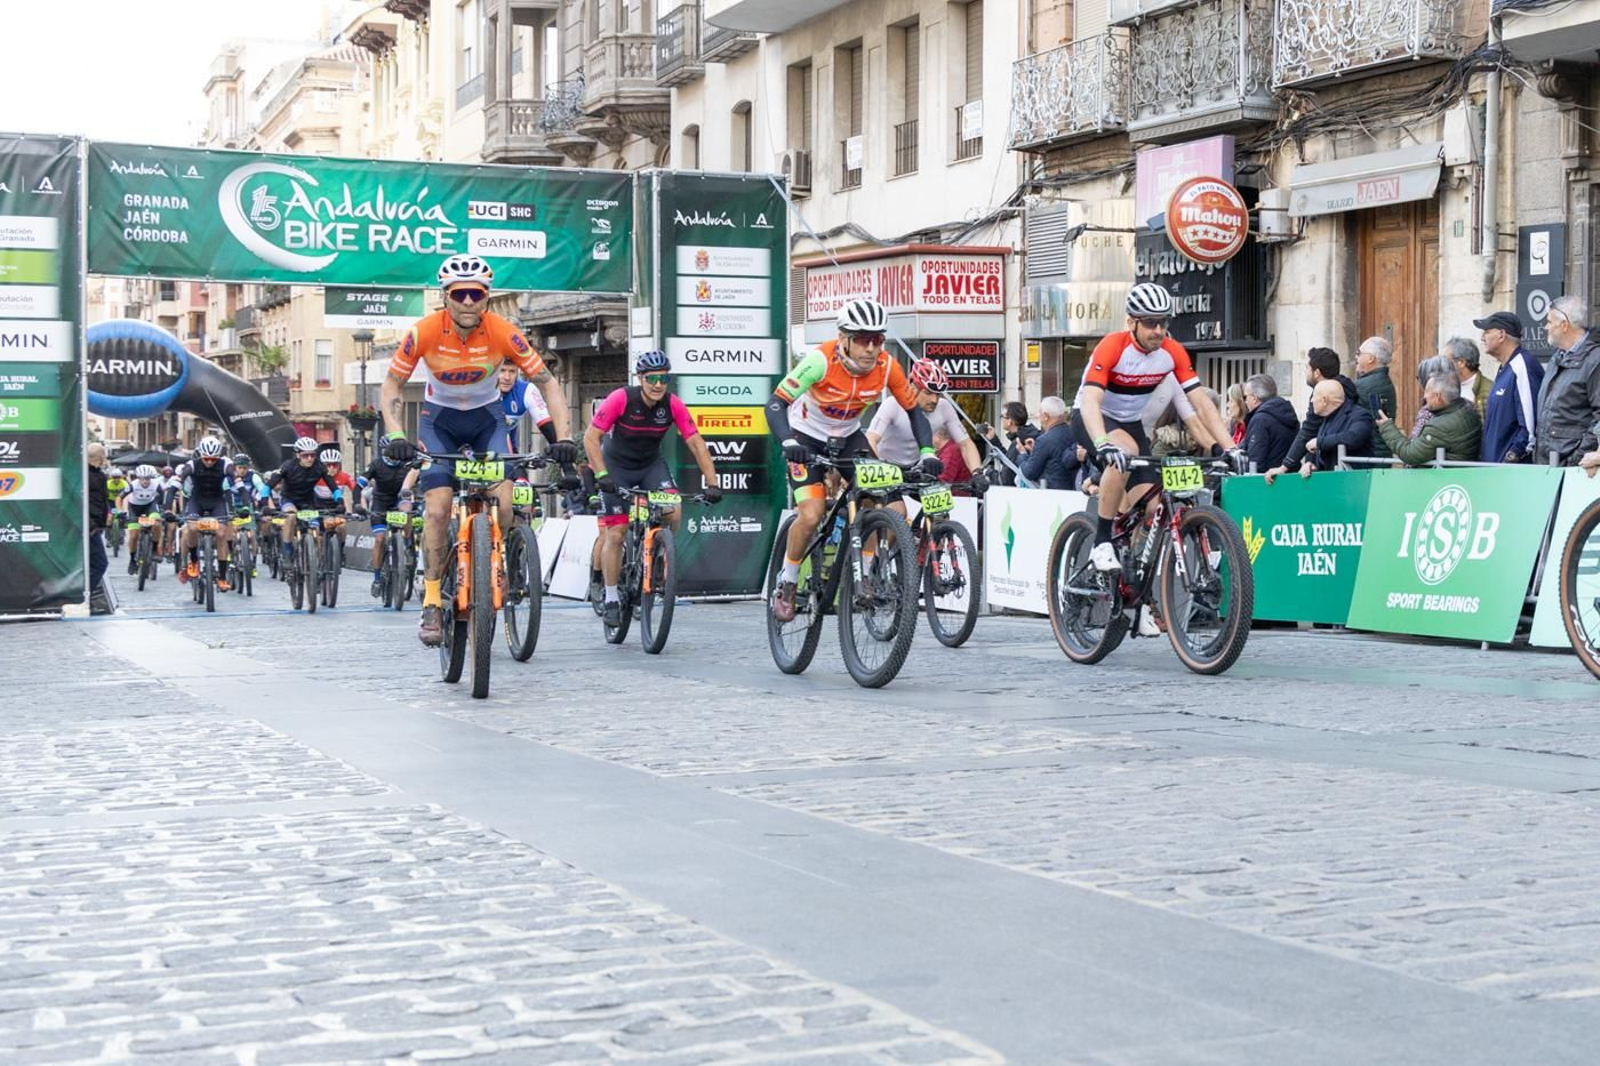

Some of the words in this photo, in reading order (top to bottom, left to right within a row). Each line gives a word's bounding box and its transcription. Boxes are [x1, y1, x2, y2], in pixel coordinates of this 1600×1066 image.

[110, 160, 169, 177] Andalucía
[124, 193, 189, 210] GRANADA
[282, 178, 457, 228] Andalucía
[124, 208, 160, 225] JAÉN
[475, 203, 504, 218] UCI
[510, 206, 532, 218] SHC
[673, 209, 736, 228] Andalucía
[1181, 207, 1242, 227] Mahou
[124, 226, 189, 244] CÓRDOBA
[284, 220, 359, 251] BIKE
[368, 226, 458, 255] RACE
[476, 236, 538, 249] GARMIN
[1071, 235, 1123, 248] UCHE
[921, 260, 1000, 274] OPORTUNIDADES
[808, 268, 872, 299] OPORTUNIDADES
[876, 263, 914, 307] JAVIER
[923, 274, 1000, 296] JAVIER
[346, 292, 390, 303] STAGE
[393, 294, 404, 303] 4
[922, 295, 950, 304] TODO
[953, 296, 967, 304] EN
[970, 296, 1001, 304] TELAS
[363, 302, 387, 315] JAÉN
[809, 301, 831, 313] TODO
[833, 300, 844, 310] EN
[1065, 302, 1112, 320] HORA
[1195, 320, 1222, 340] 1974
[685, 349, 762, 364] GARMIN
[926, 344, 997, 356] OPORTUNIDADES
[229, 411, 274, 423] garmin.com
[697, 414, 752, 428] PIRELLI
[460, 460, 499, 477] 324-1
[860, 465, 900, 484] 324-2
[1165, 470, 1201, 487] 314-2
[923, 492, 952, 509] 322-2
[1270, 523, 1309, 547] CAJA
[1312, 522, 1363, 547] RURAL
[1396, 511, 1500, 567] ISB
[1297, 551, 1336, 577] JAÉN
[1386, 592, 1422, 610] SPORT
[1423, 594, 1481, 614] BEARINGS
